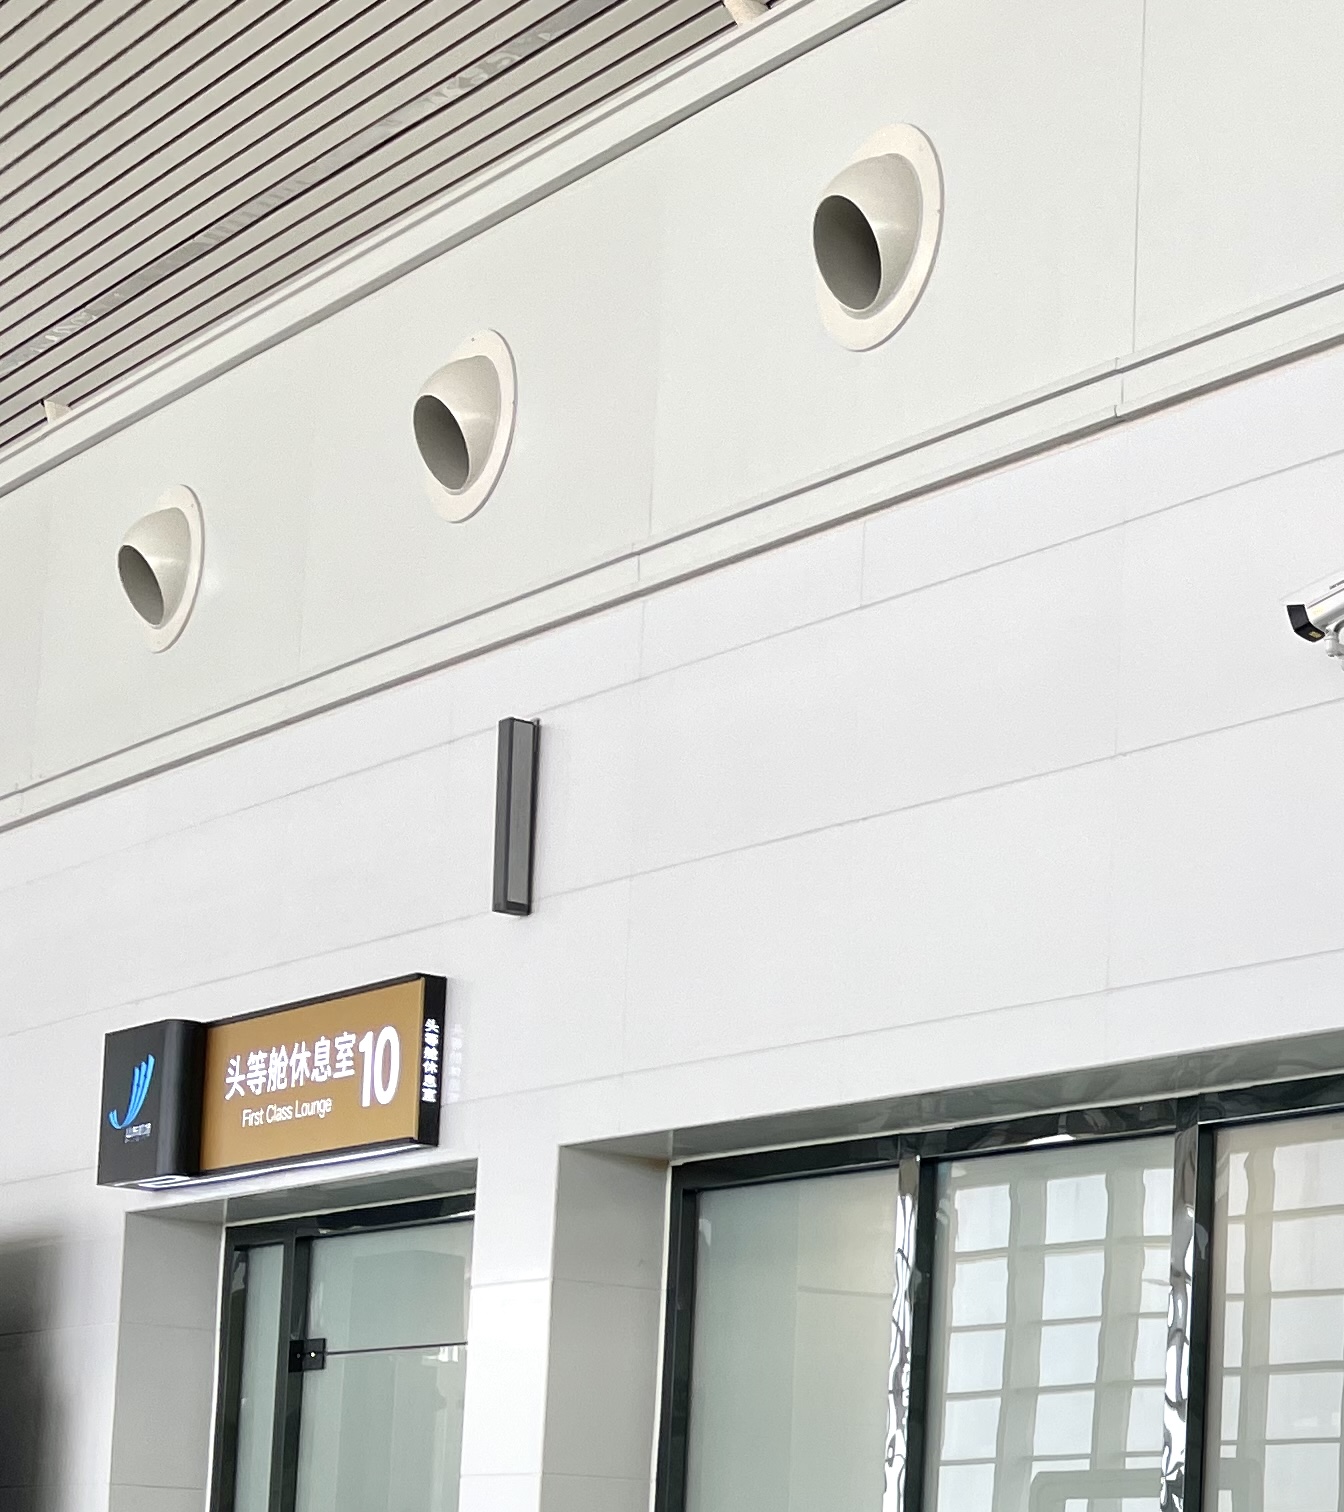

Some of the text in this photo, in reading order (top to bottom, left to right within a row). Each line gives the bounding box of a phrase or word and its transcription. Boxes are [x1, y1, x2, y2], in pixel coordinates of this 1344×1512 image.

[225, 1031, 357, 1101] 头等舱休息室
[358, 1025, 400, 1108] 10
[242, 1097, 333, 1127] First Class Lounge
